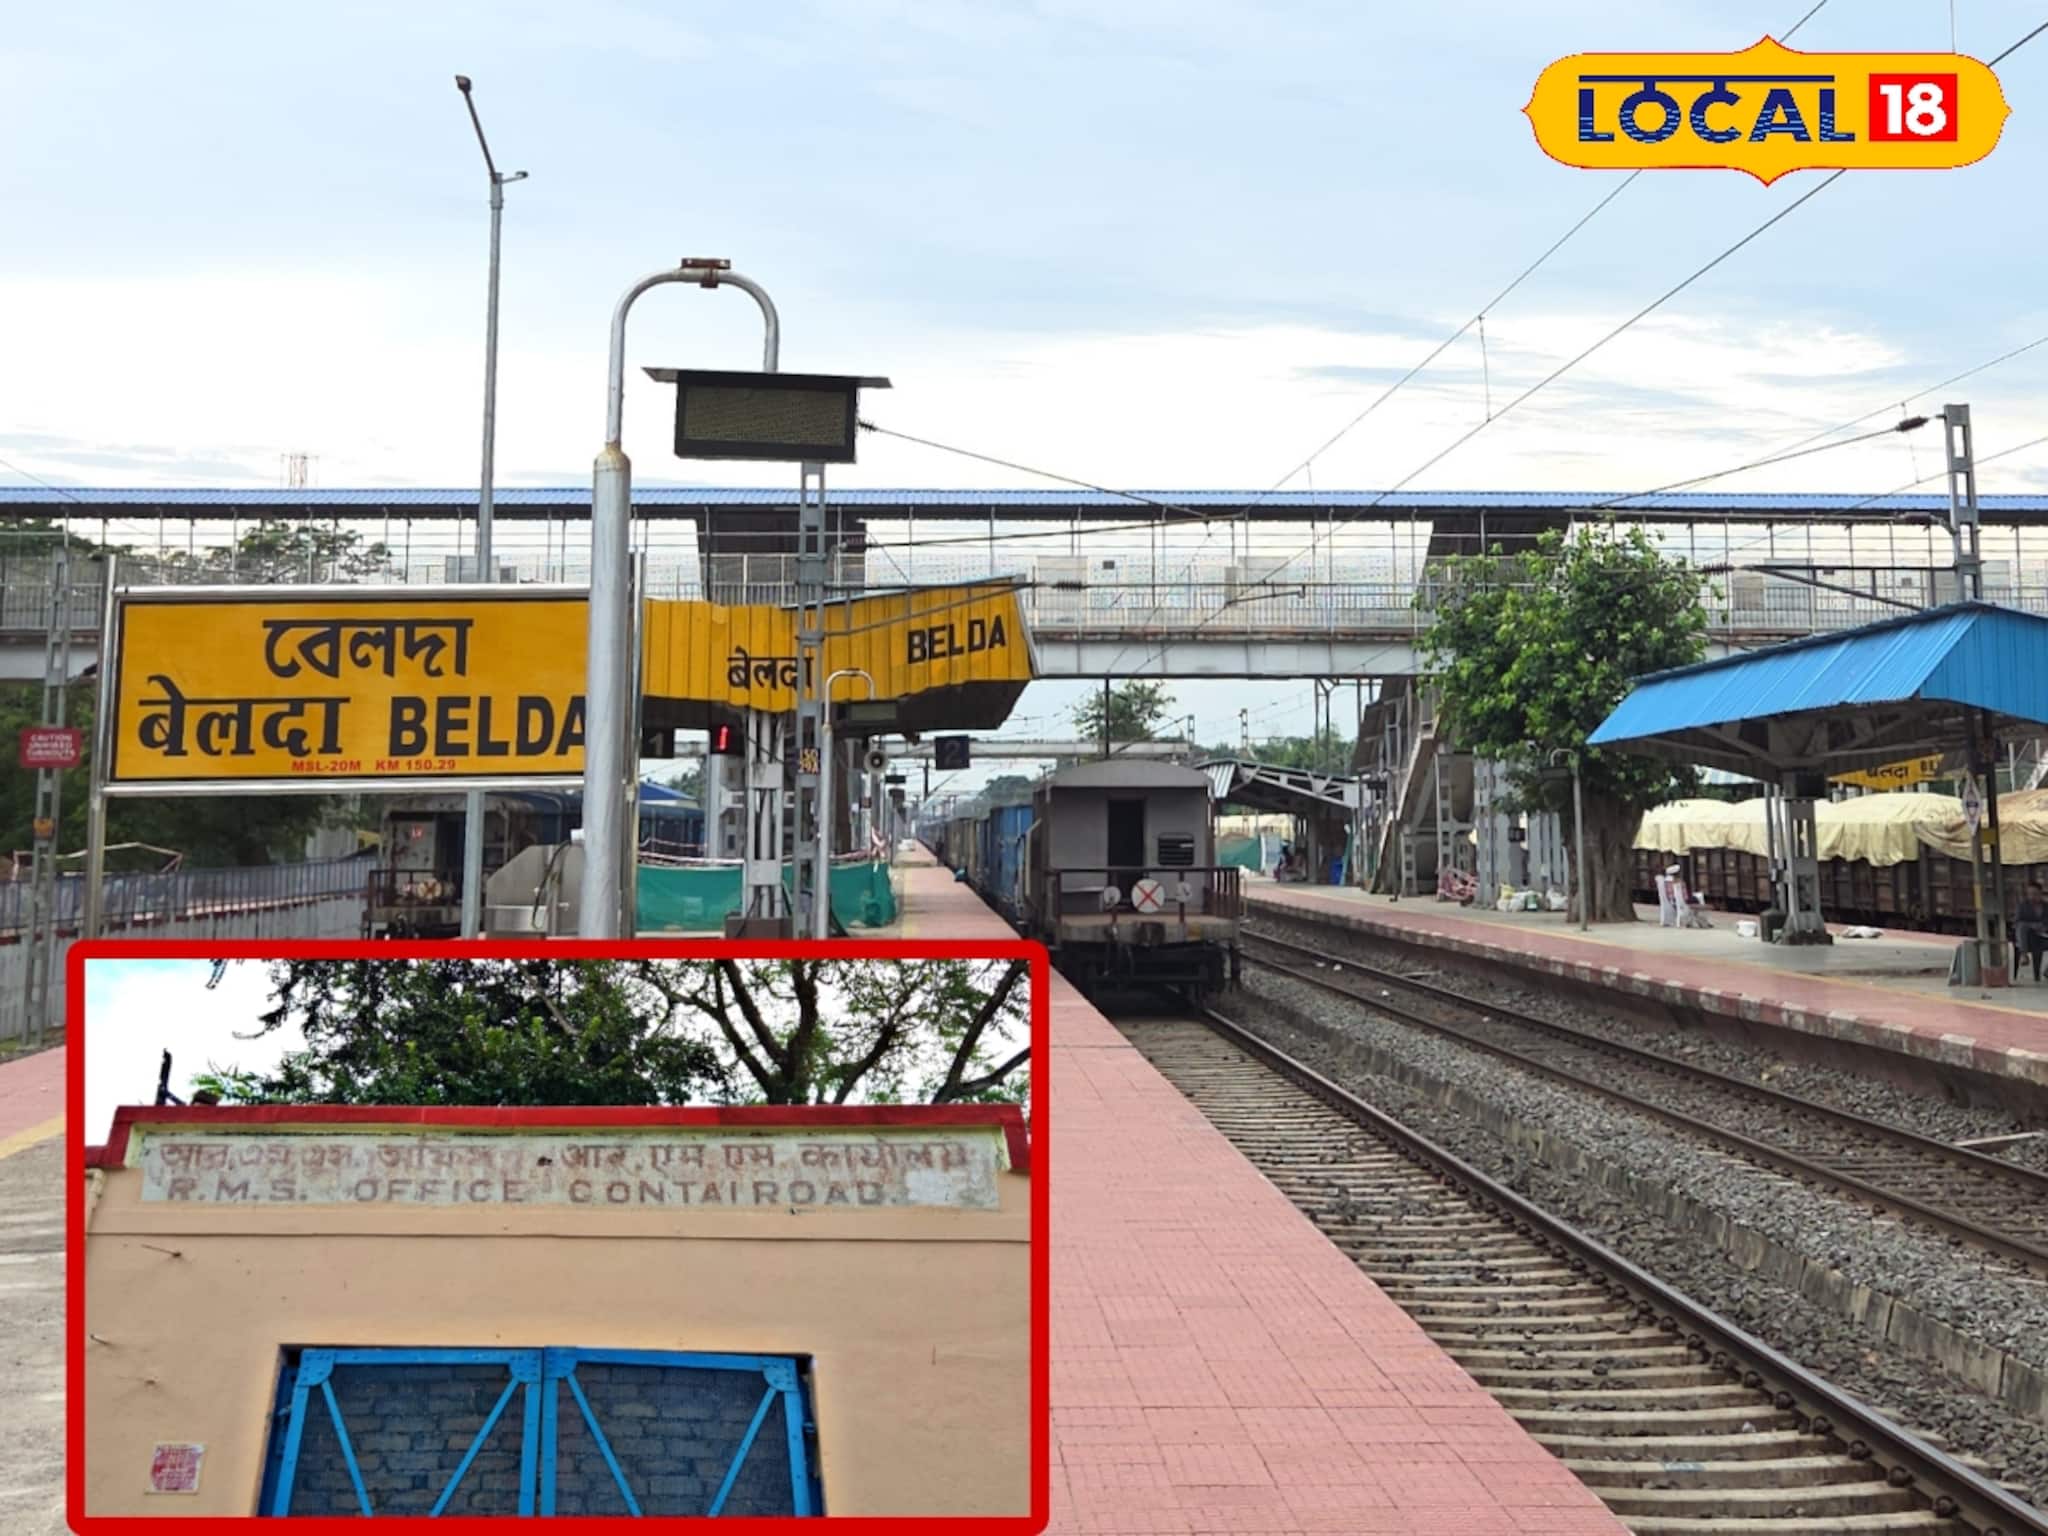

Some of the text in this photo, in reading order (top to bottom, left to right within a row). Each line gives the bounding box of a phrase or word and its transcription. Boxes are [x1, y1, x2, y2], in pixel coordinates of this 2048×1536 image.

[263, 618, 474, 679] বেলদা
[908, 615, 1007, 664] BELDA
[727, 645, 814, 691] बेलदा
[138, 674, 350, 758] बेलदा
[388, 695, 588, 757] BELDA
[291, 758, 457, 772] MSL-20M KM 150.29
[648, 733, 664, 756] 1
[354, 1178, 528, 1203] OFFICE
